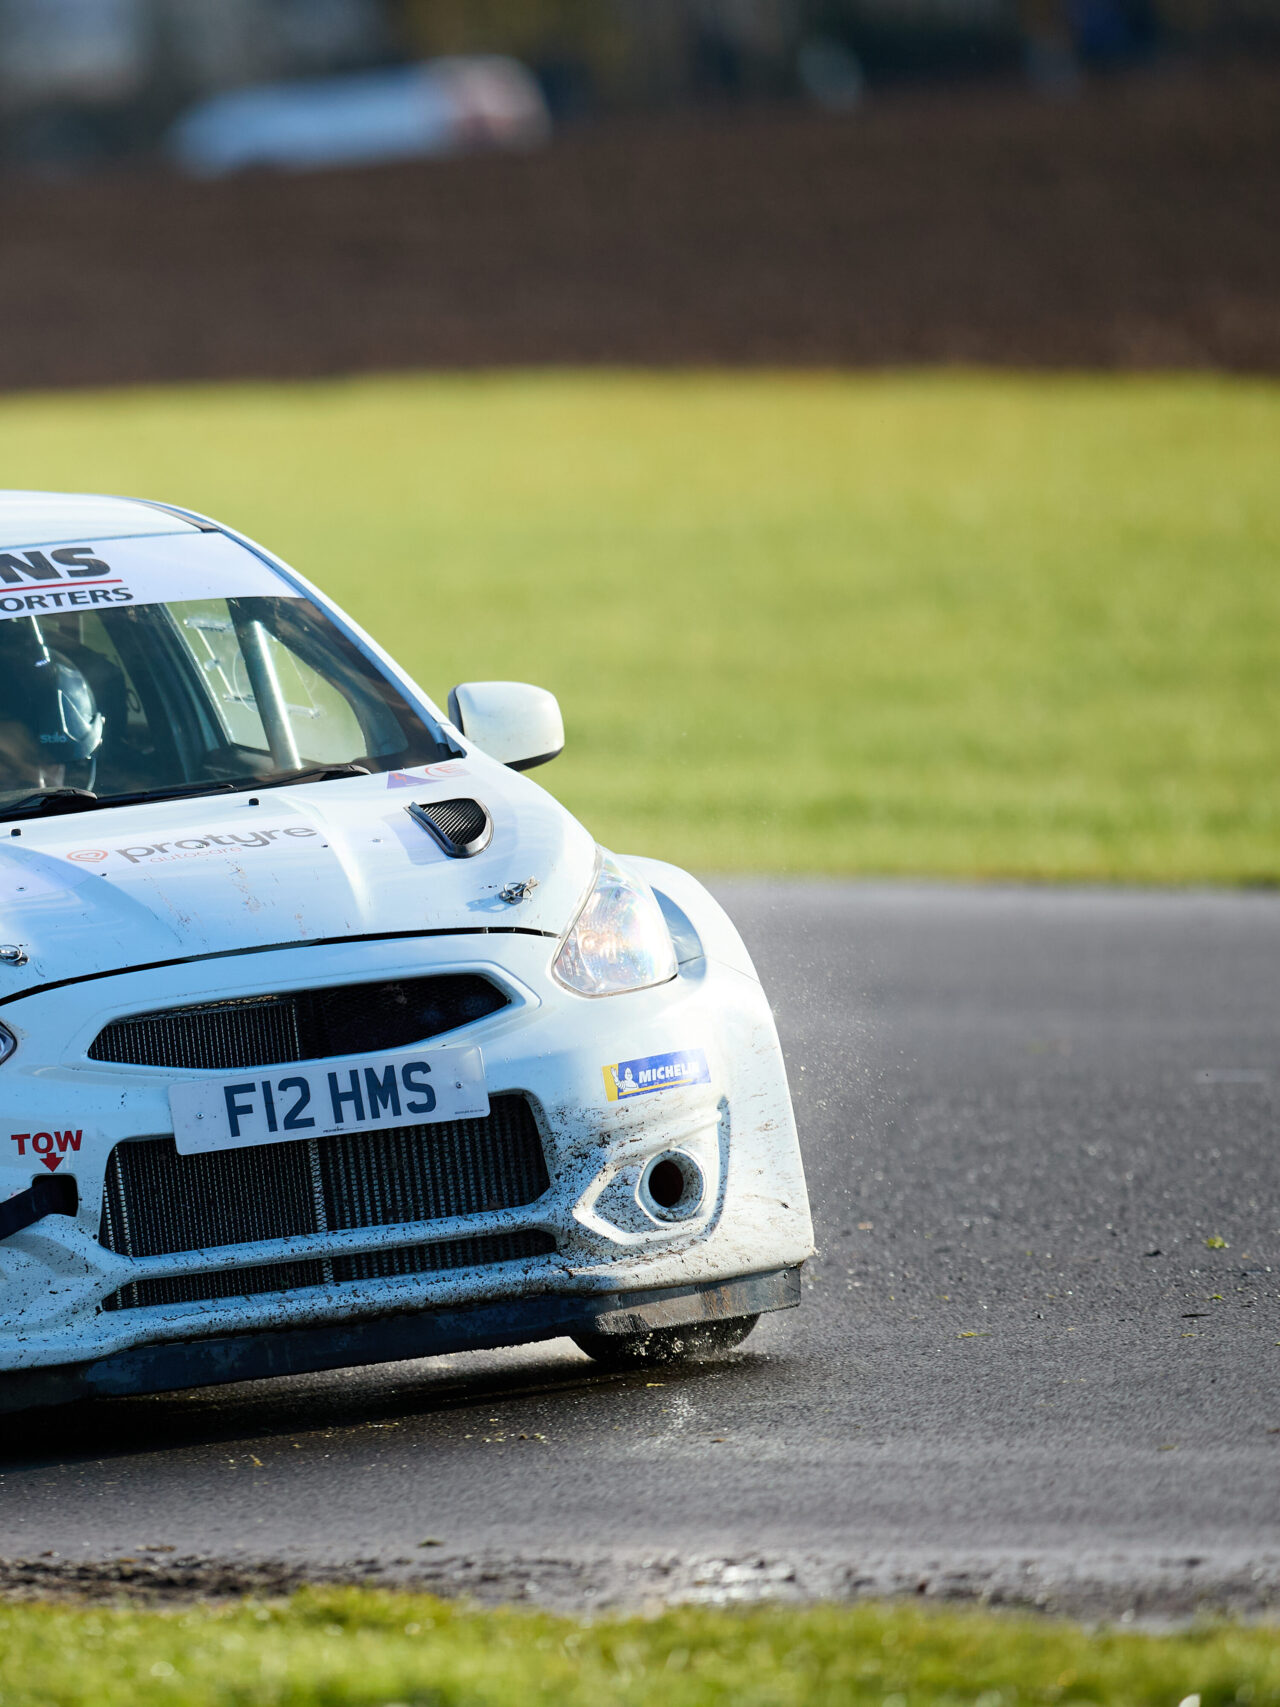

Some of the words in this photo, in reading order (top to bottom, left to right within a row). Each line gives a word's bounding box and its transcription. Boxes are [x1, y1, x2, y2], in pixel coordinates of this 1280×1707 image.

[115, 827, 318, 864] protyre
[150, 846, 242, 863] autocare
[638, 1061, 700, 1083] MICHELIN
[224, 1076, 315, 1137] F12
[327, 1061, 437, 1124] HMS
[10, 1129, 83, 1155] TOW
